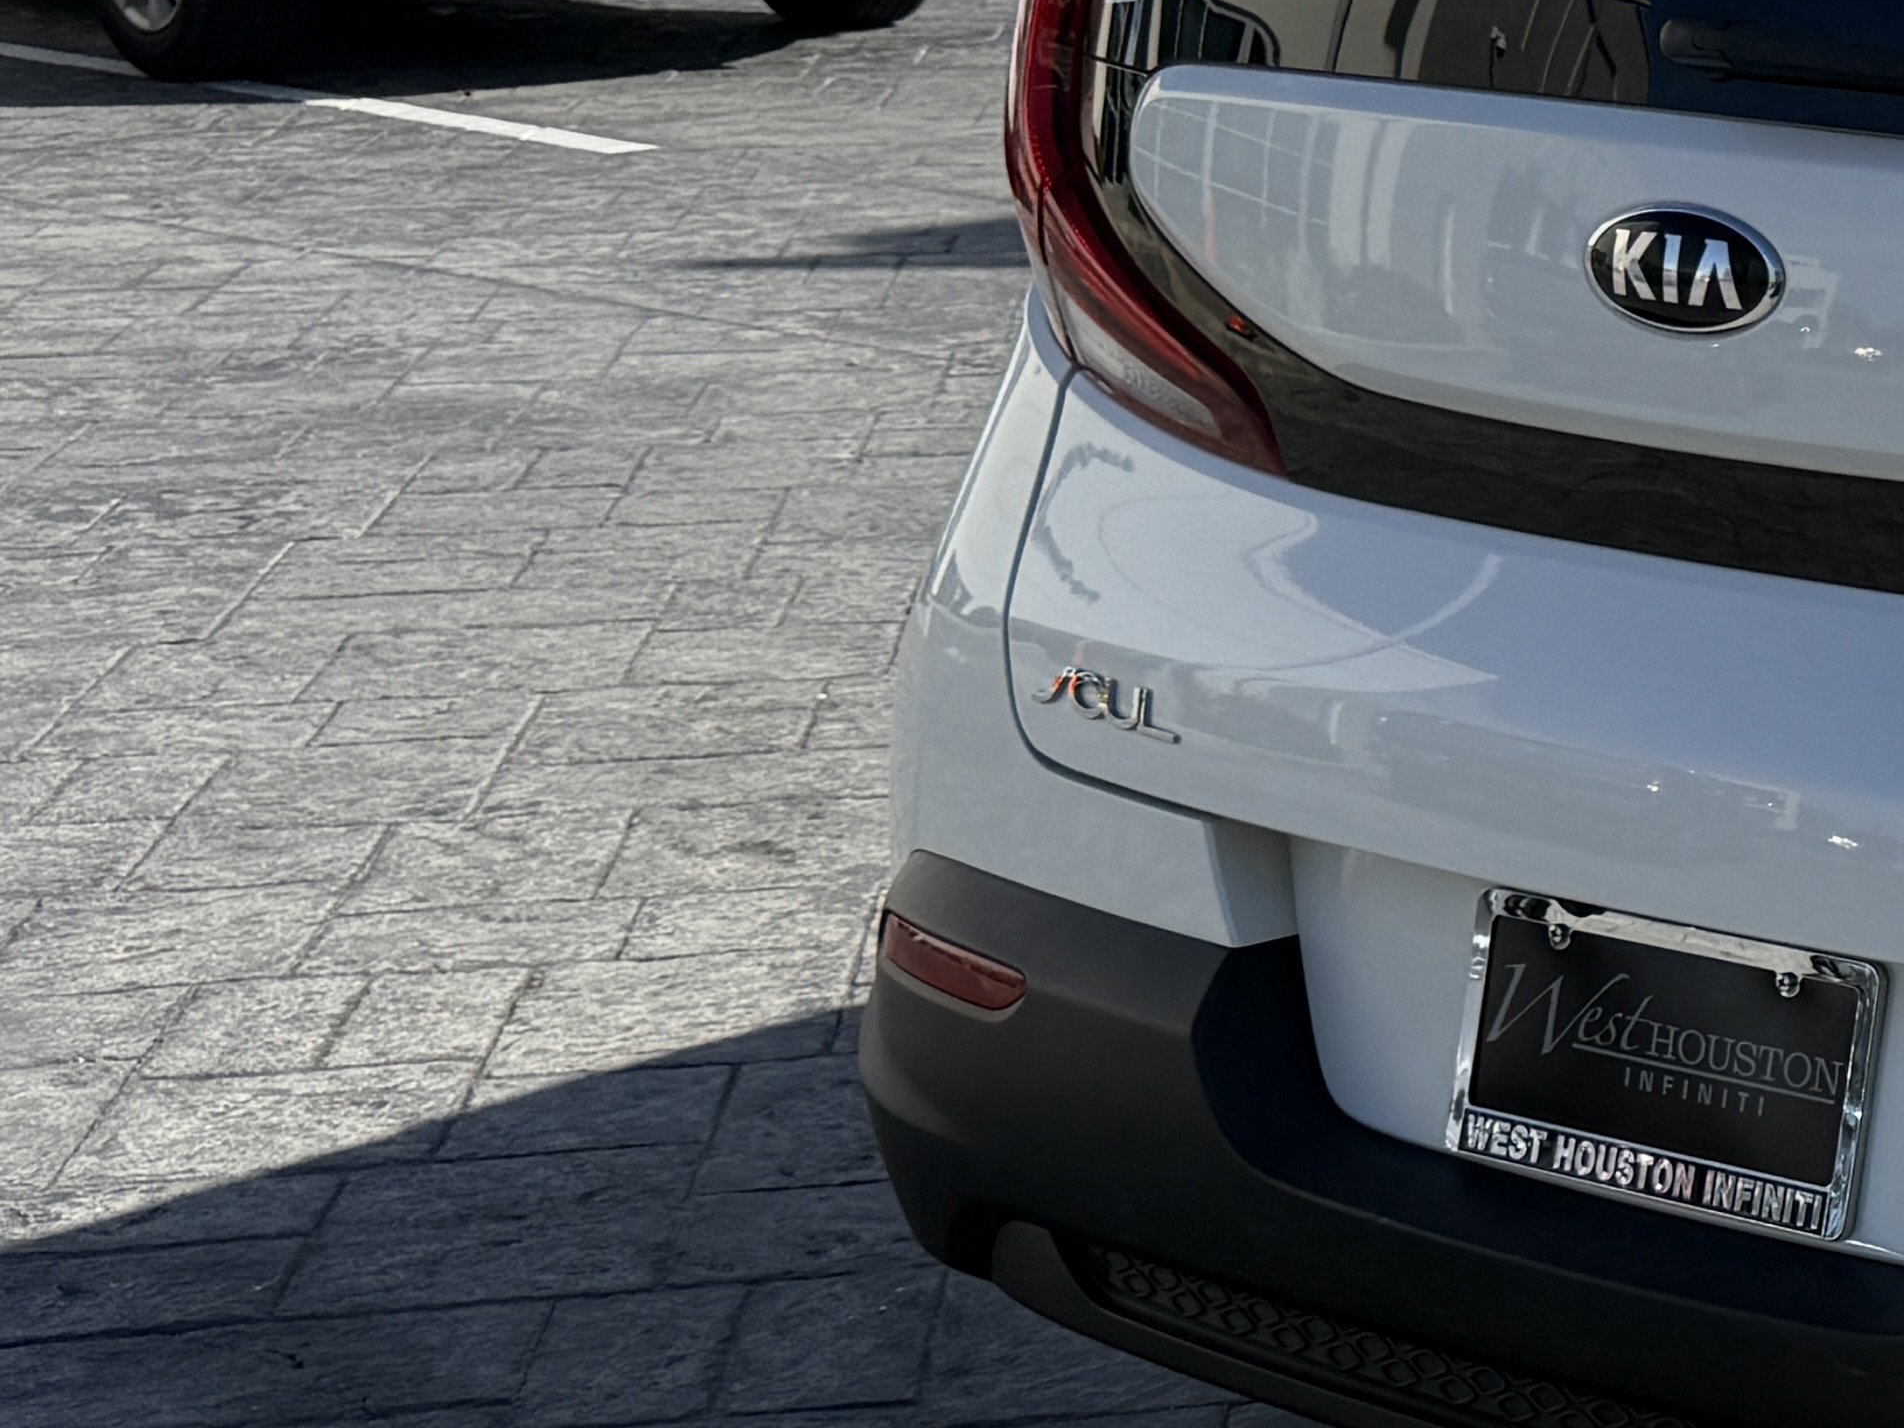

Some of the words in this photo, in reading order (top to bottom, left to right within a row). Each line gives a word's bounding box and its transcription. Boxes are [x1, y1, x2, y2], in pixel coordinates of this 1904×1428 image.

[1611, 228, 1743, 310] KIA
[1623, 1066, 1767, 1118] INFINITI
[1649, 1027, 1846, 1096] HOUSTON
[1466, 1113, 1548, 1166] WEST
[1552, 1136, 1696, 1202] HOUSTON
[1701, 1169, 1824, 1231] INFINITI
